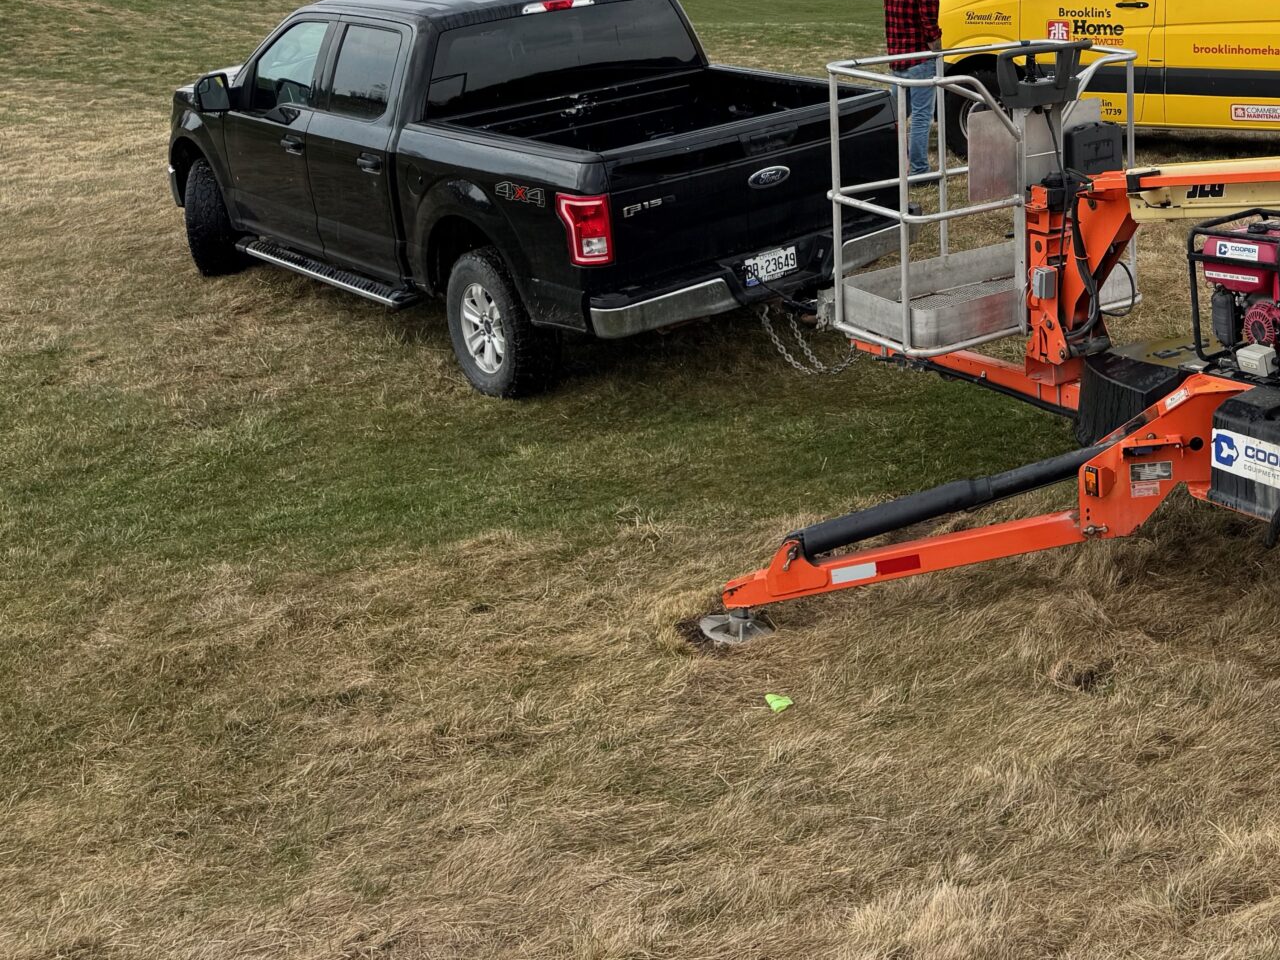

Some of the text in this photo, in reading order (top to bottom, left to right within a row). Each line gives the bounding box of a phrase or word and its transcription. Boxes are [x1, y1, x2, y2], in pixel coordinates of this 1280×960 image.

[1058, 7, 1112, 18] Brooklin's
[1072, 19, 1124, 36] Home
[1072, 35, 1124, 46] hdware
[1230, 245, 1257, 254] COOPER
[765, 252, 796, 274] 23649
[1243, 463, 1280, 481] EQUIPMENT
